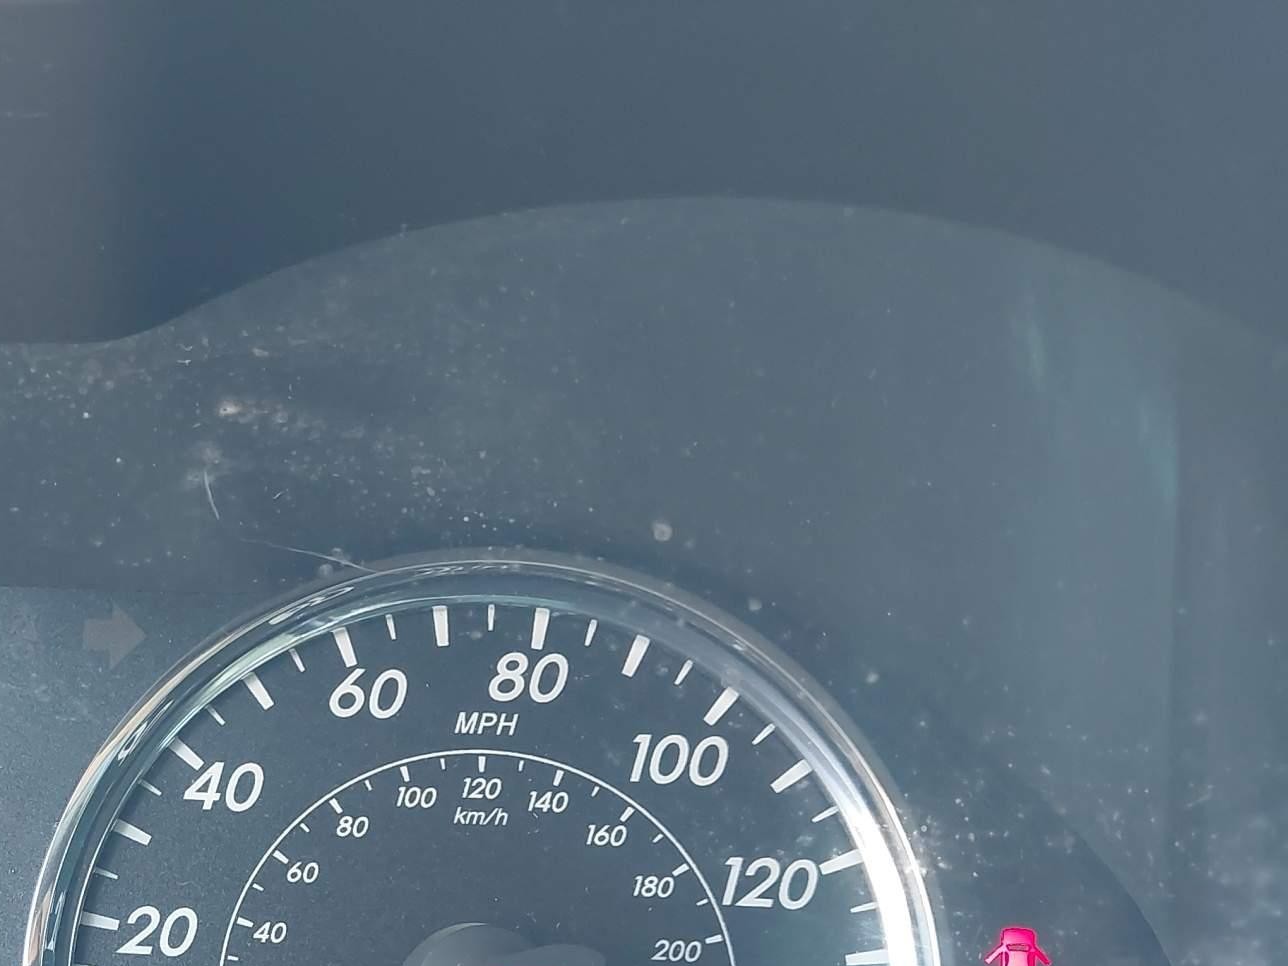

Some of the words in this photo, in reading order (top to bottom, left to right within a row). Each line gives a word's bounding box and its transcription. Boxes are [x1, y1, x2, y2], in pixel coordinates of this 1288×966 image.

[488, 652, 569, 703] 80
[328, 668, 408, 719] 60
[454, 712, 519, 736] MPH
[629, 734, 729, 786] 100
[183, 762, 264, 812] 40
[396, 787, 437, 808] 100
[462, 777, 502, 799] 120
[528, 791, 569, 813] 140
[336, 816, 369, 838] 80
[454, 806, 509, 827] km/h
[586, 824, 627, 847] 160
[286, 862, 319, 883] 60
[722, 857, 819, 909] 120
[633, 876, 674, 898] 180
[115, 905, 199, 957] 20
[253, 922, 287, 944] 40
[652, 940, 702, 962] 200
